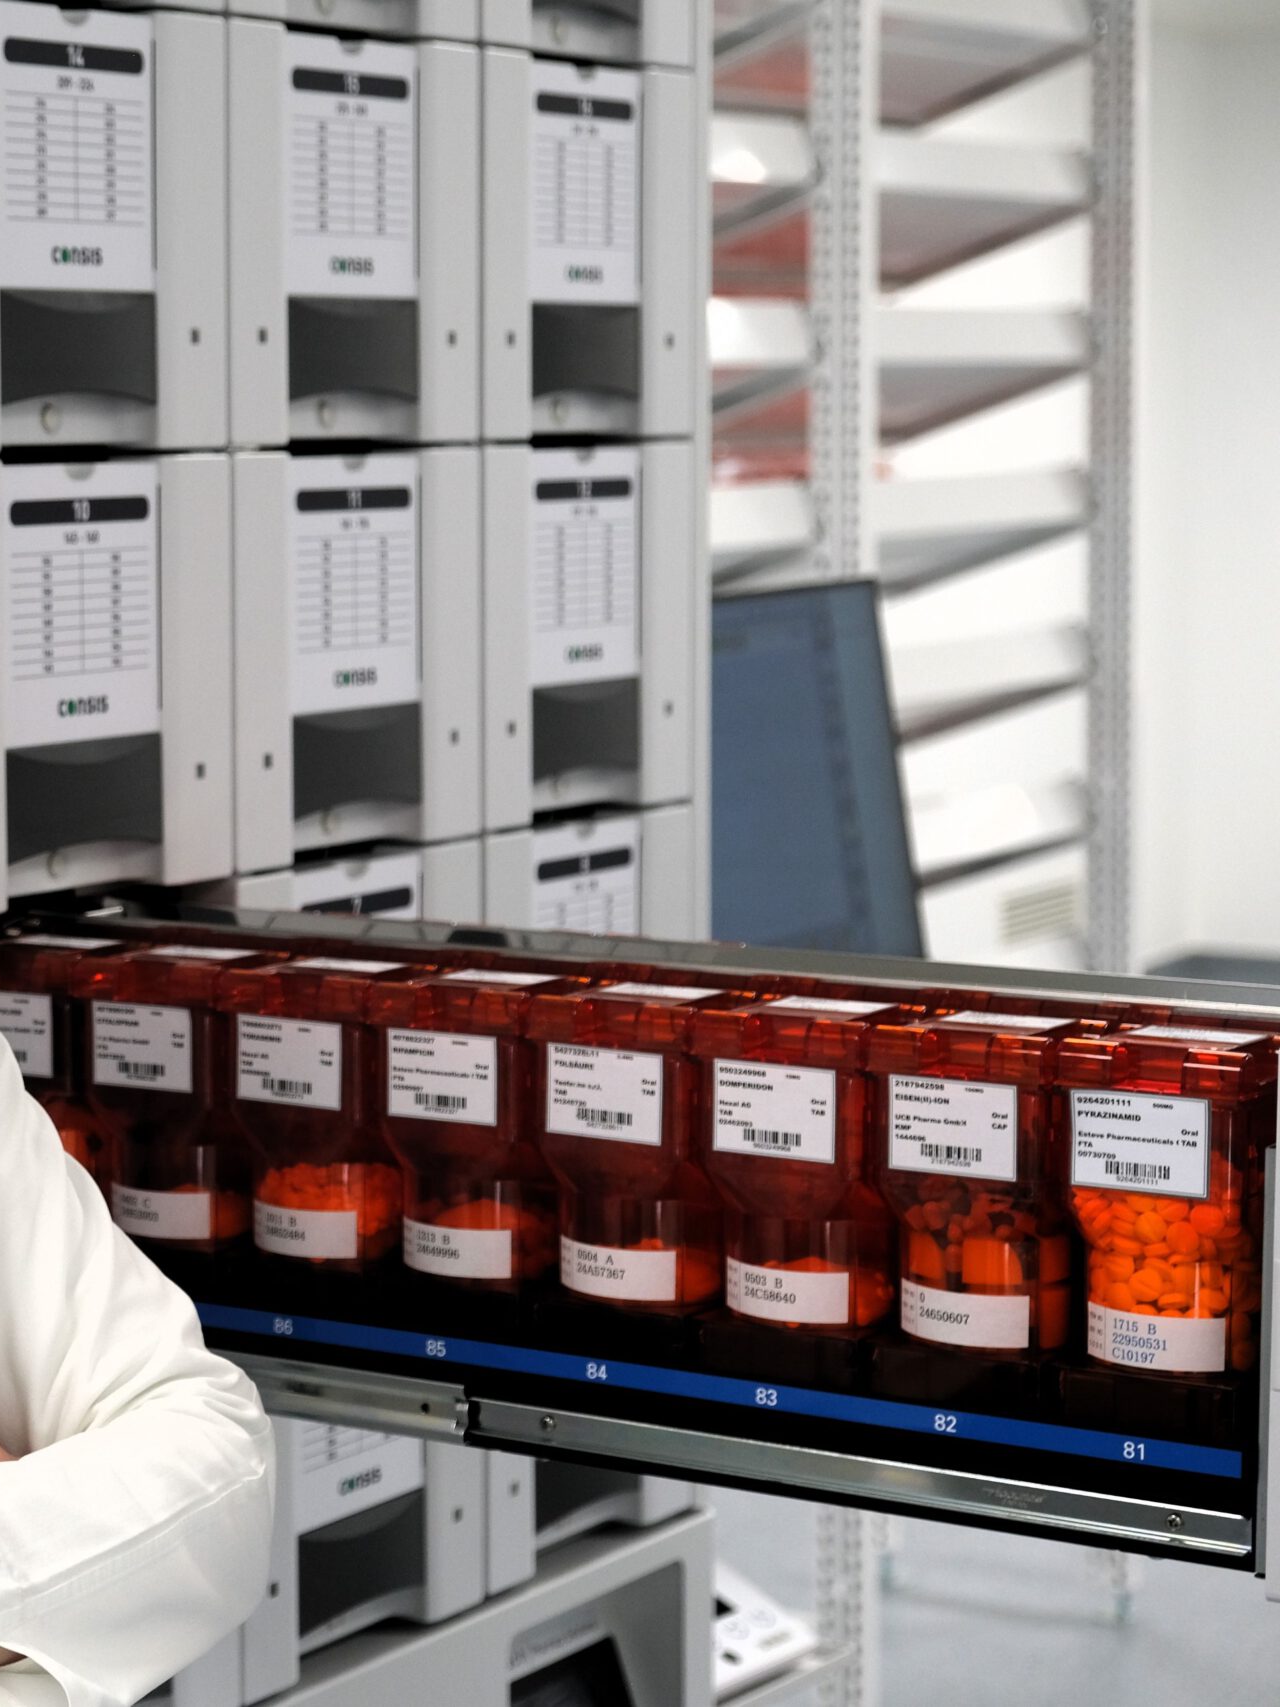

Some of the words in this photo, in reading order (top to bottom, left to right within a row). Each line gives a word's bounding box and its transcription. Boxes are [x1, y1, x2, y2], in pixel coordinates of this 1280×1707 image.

[67, 44, 85, 67] 14
[393, 1047, 435, 1056] RIFAMPICIN
[720, 1080, 773, 1091] DOMPERIDON
[895, 1094, 950, 1104] EISEN(II)-ION
[1077, 1096, 1131, 1106] 9264201111
[913, 1116, 941, 1124] Pharma
[1078, 1110, 1141, 1121] PYRAZINAMID
[1107, 1133, 1173, 1145] Pharmaceuticals
[442, 1235, 450, 1245] B
[577, 1248, 597, 1262] 0504
[606, 1255, 614, 1265] A
[745, 1272, 767, 1286] 0503
[775, 1278, 782, 1289] B
[920, 1292, 925, 1302] 0
[920, 1306, 969, 1325] 24650607
[274, 1318, 293, 1335] 86
[1113, 1318, 1138, 1332] 1715
[1148, 1324, 1157, 1335] B
[426, 1340, 446, 1357] 85
[1112, 1333, 1167, 1351] 22950531
[1112, 1348, 1155, 1364] C10197
[586, 1363, 607, 1380] 84
[754, 1387, 778, 1406] 83
[934, 1414, 957, 1433] 82
[1123, 1441, 1145, 1461] 81
